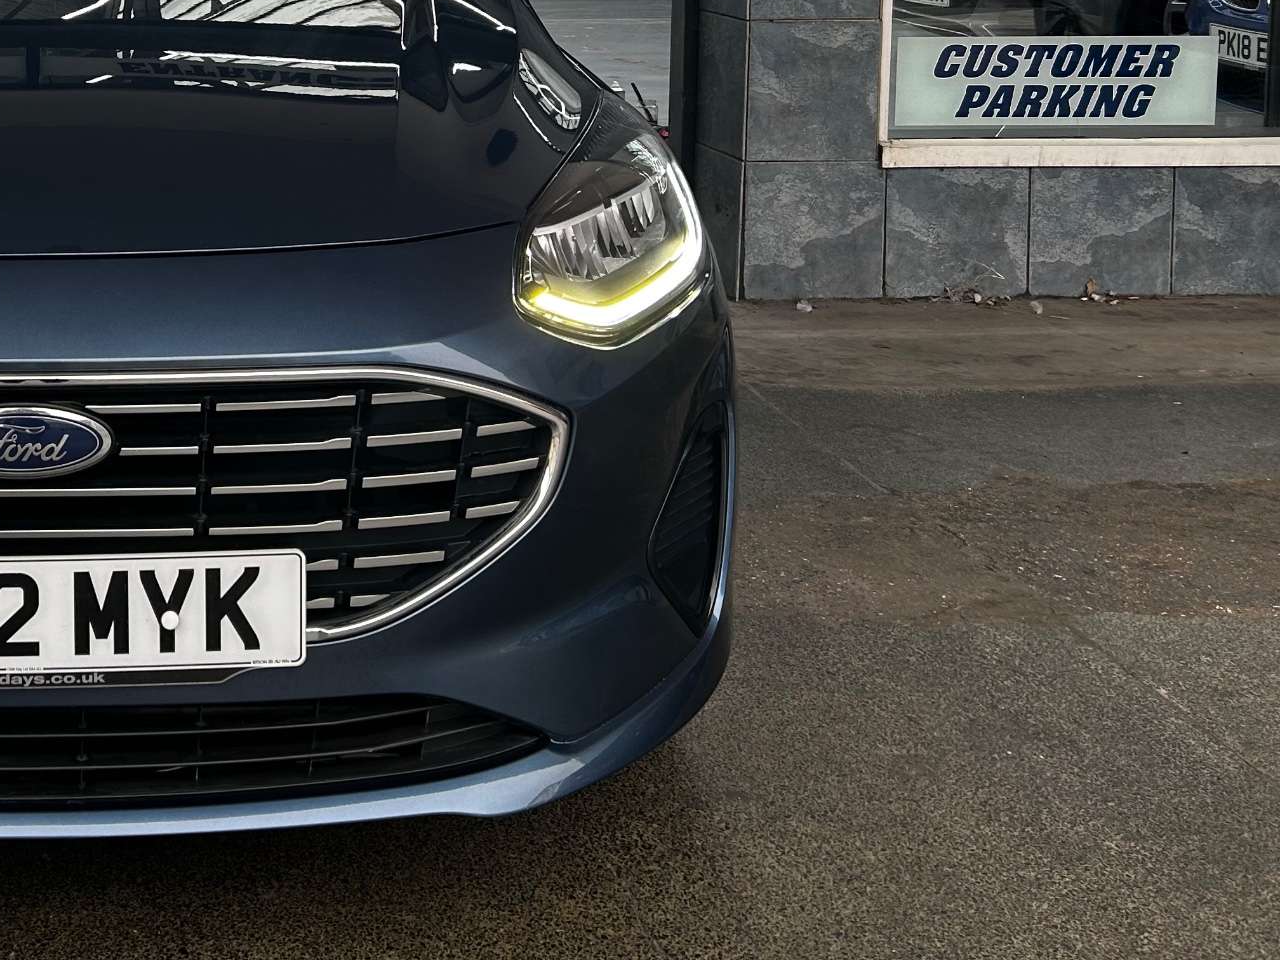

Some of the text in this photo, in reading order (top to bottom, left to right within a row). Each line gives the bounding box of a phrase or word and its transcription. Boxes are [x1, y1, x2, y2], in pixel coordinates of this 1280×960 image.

[933, 44, 1180, 78] CUSTOMER
[1218, 29, 1251, 60] PK18
[955, 84, 1156, 118] PARKING
[73, 566, 260, 656] MYK
